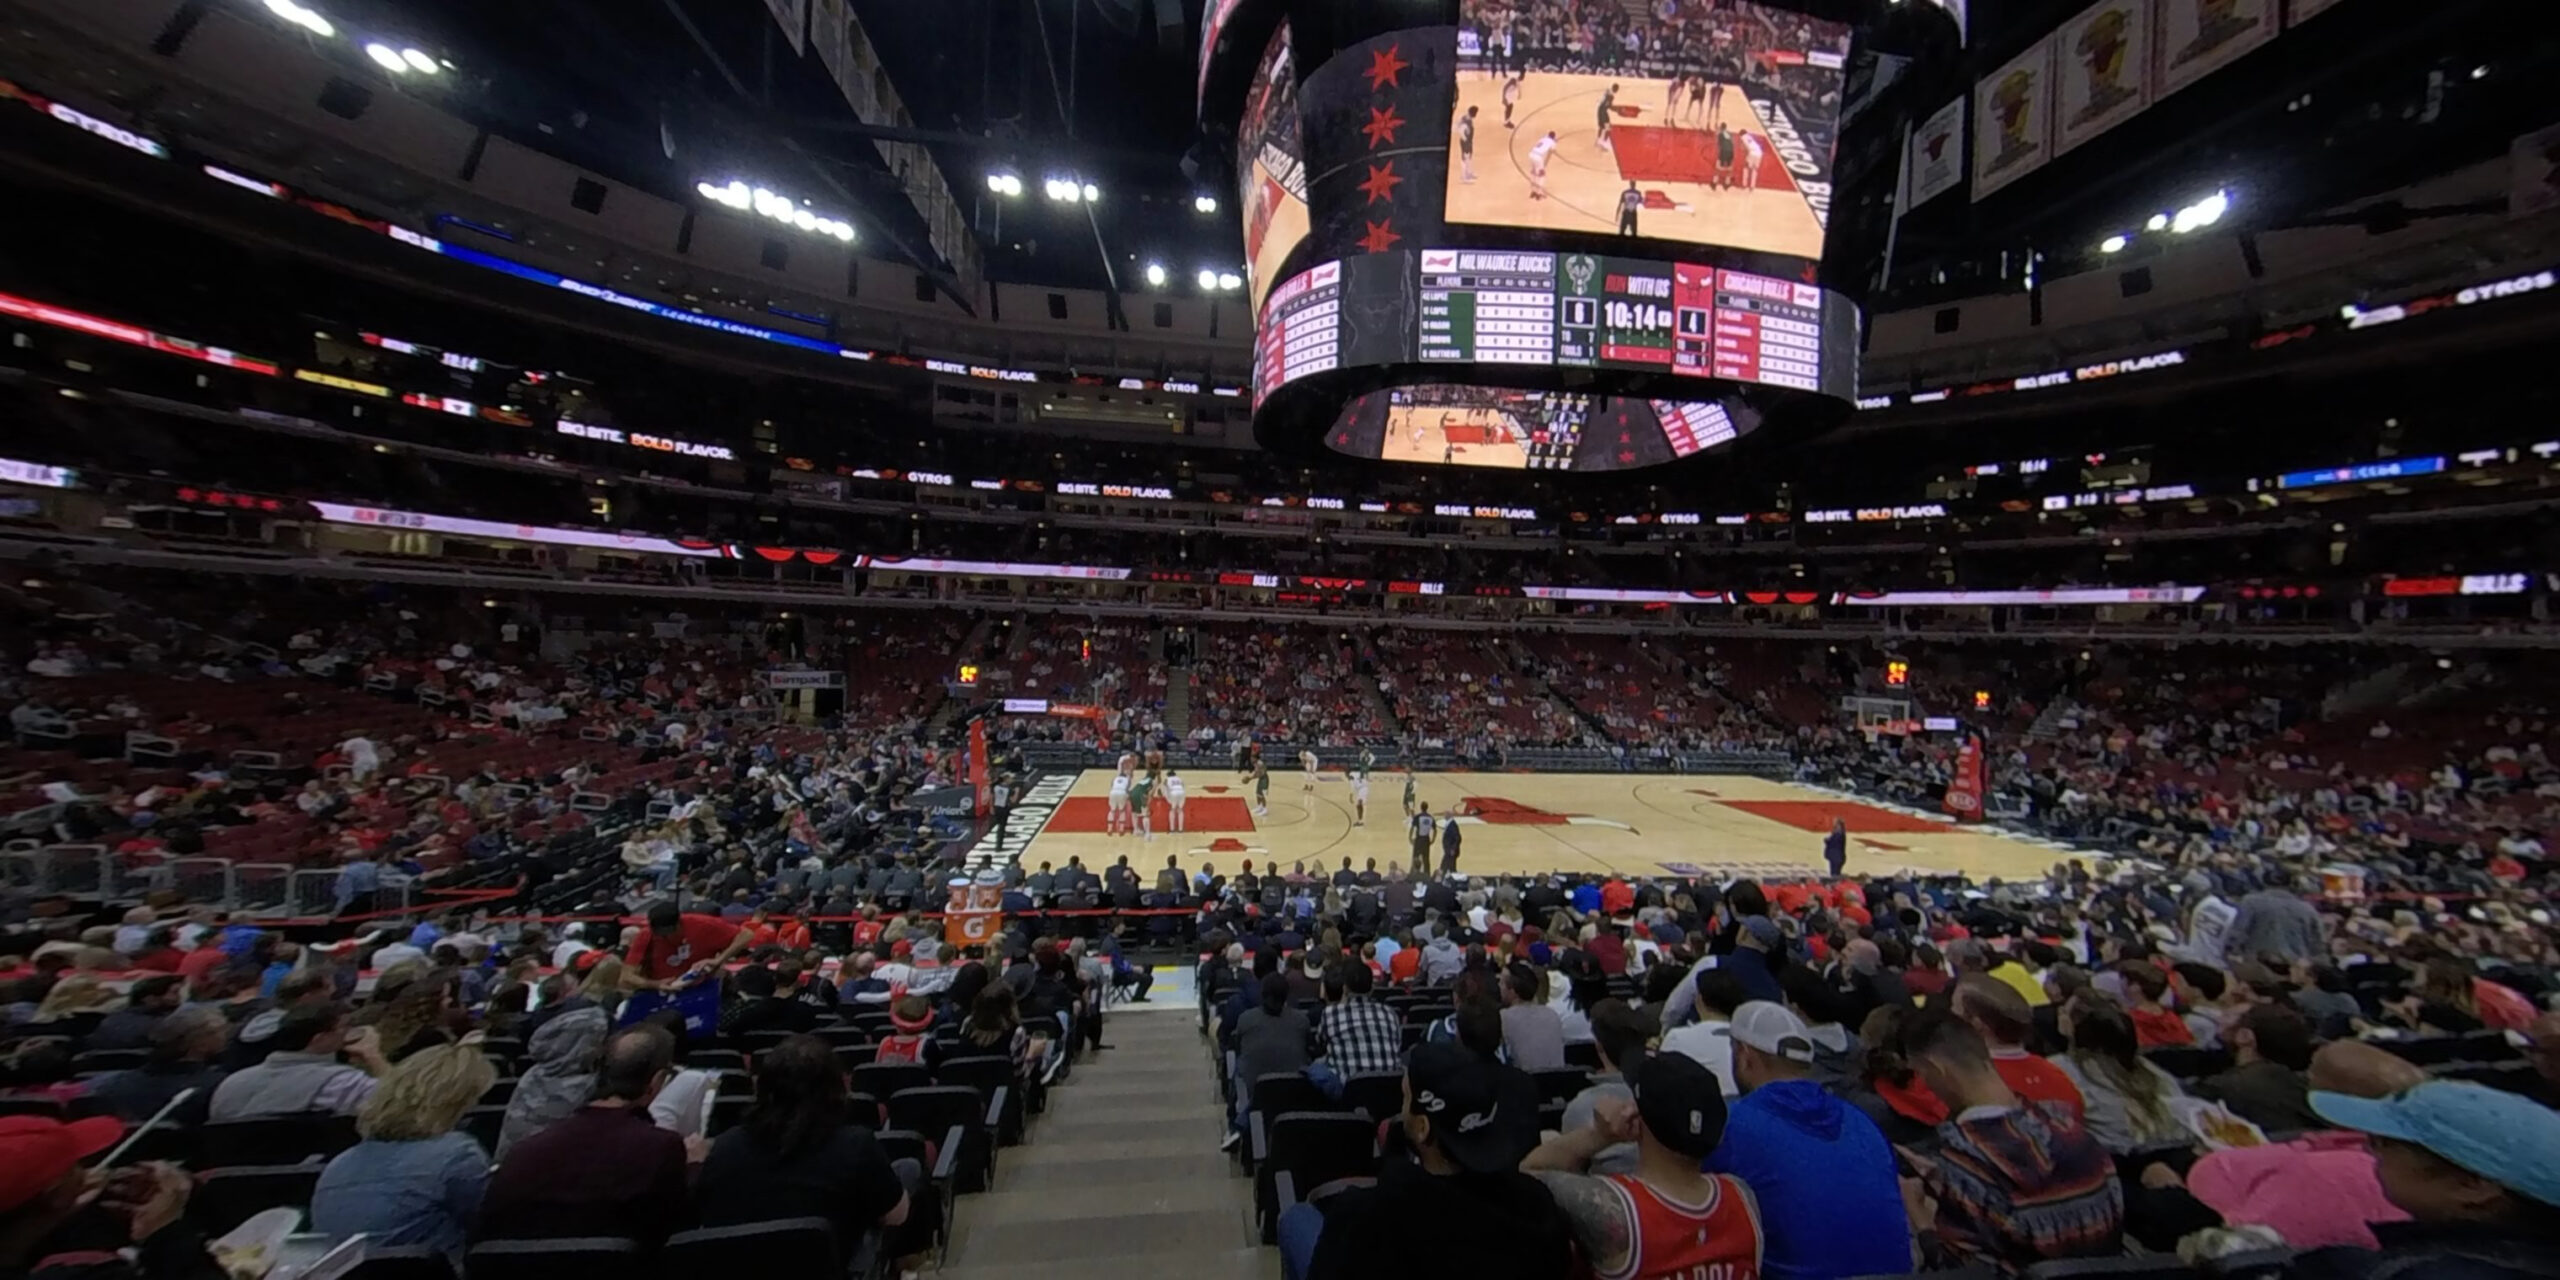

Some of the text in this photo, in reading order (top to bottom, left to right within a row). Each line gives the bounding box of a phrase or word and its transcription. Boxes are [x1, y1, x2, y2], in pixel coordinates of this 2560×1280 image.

[1459, 254, 1553, 273] MILWAUKEE BUCKS
[1628, 275, 1655, 297] WITH
[1655, 278, 1671, 298] US
[2456, 271, 2555, 305] GYROS
[1604, 301, 1657, 331] 10:14
[1689, 312, 1698, 333] 4
[722, 322, 771, 340] LOUNGE
[1560, 344, 1583, 357] FOULS
[926, 360, 943, 371] BIG
[970, 366, 998, 380] BOLD
[2015, 376, 2037, 391] BIG
[2076, 362, 2119, 380] BOLD
[1163, 382, 1199, 394] GYROS
[1856, 396, 1890, 410] YROS
[557, 419, 585, 438] BIG
[631, 432, 674, 452] BOLD
[907, 471, 953, 486] GYROS
[1057, 483, 1074, 494] BIG
[1103, 485, 1131, 497] BOLD
[1307, 497, 1344, 509] GYROS
[1435, 504, 1451, 515] BIG
[1475, 506, 1500, 518] BOLD
[1661, 513, 1700, 524] GYROS
[1805, 511, 1825, 522] BIG
[1857, 508, 1892, 521] BOLD
[1252, 574, 1278, 588] BULLS
[1419, 581, 1444, 595] BULLS
[2459, 572, 2529, 596] BULLS
[963, 916, 985, 939] G
